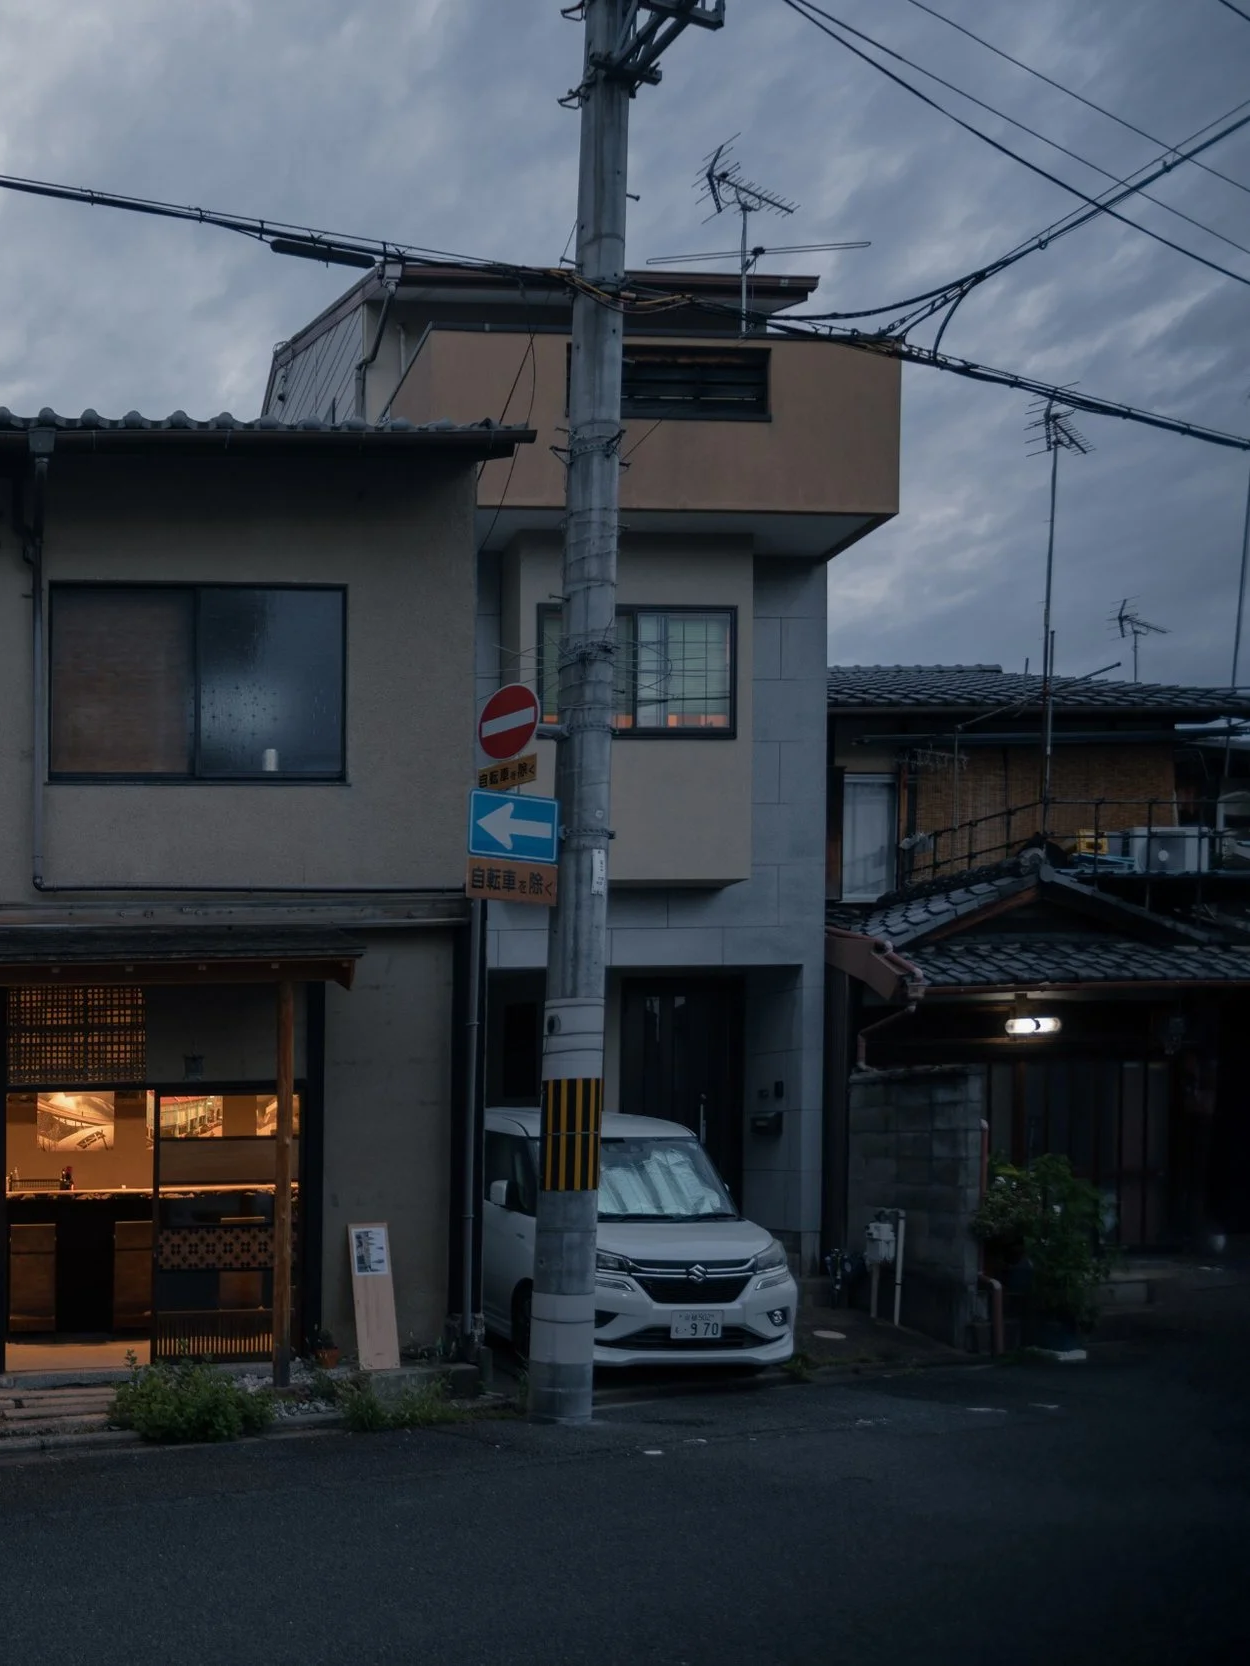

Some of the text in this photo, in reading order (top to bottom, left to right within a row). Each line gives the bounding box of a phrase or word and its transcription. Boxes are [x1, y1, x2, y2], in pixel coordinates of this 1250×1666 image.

[479, 762, 535, 788] 自転車を除く
[472, 865, 553, 897] 自転車を除く
